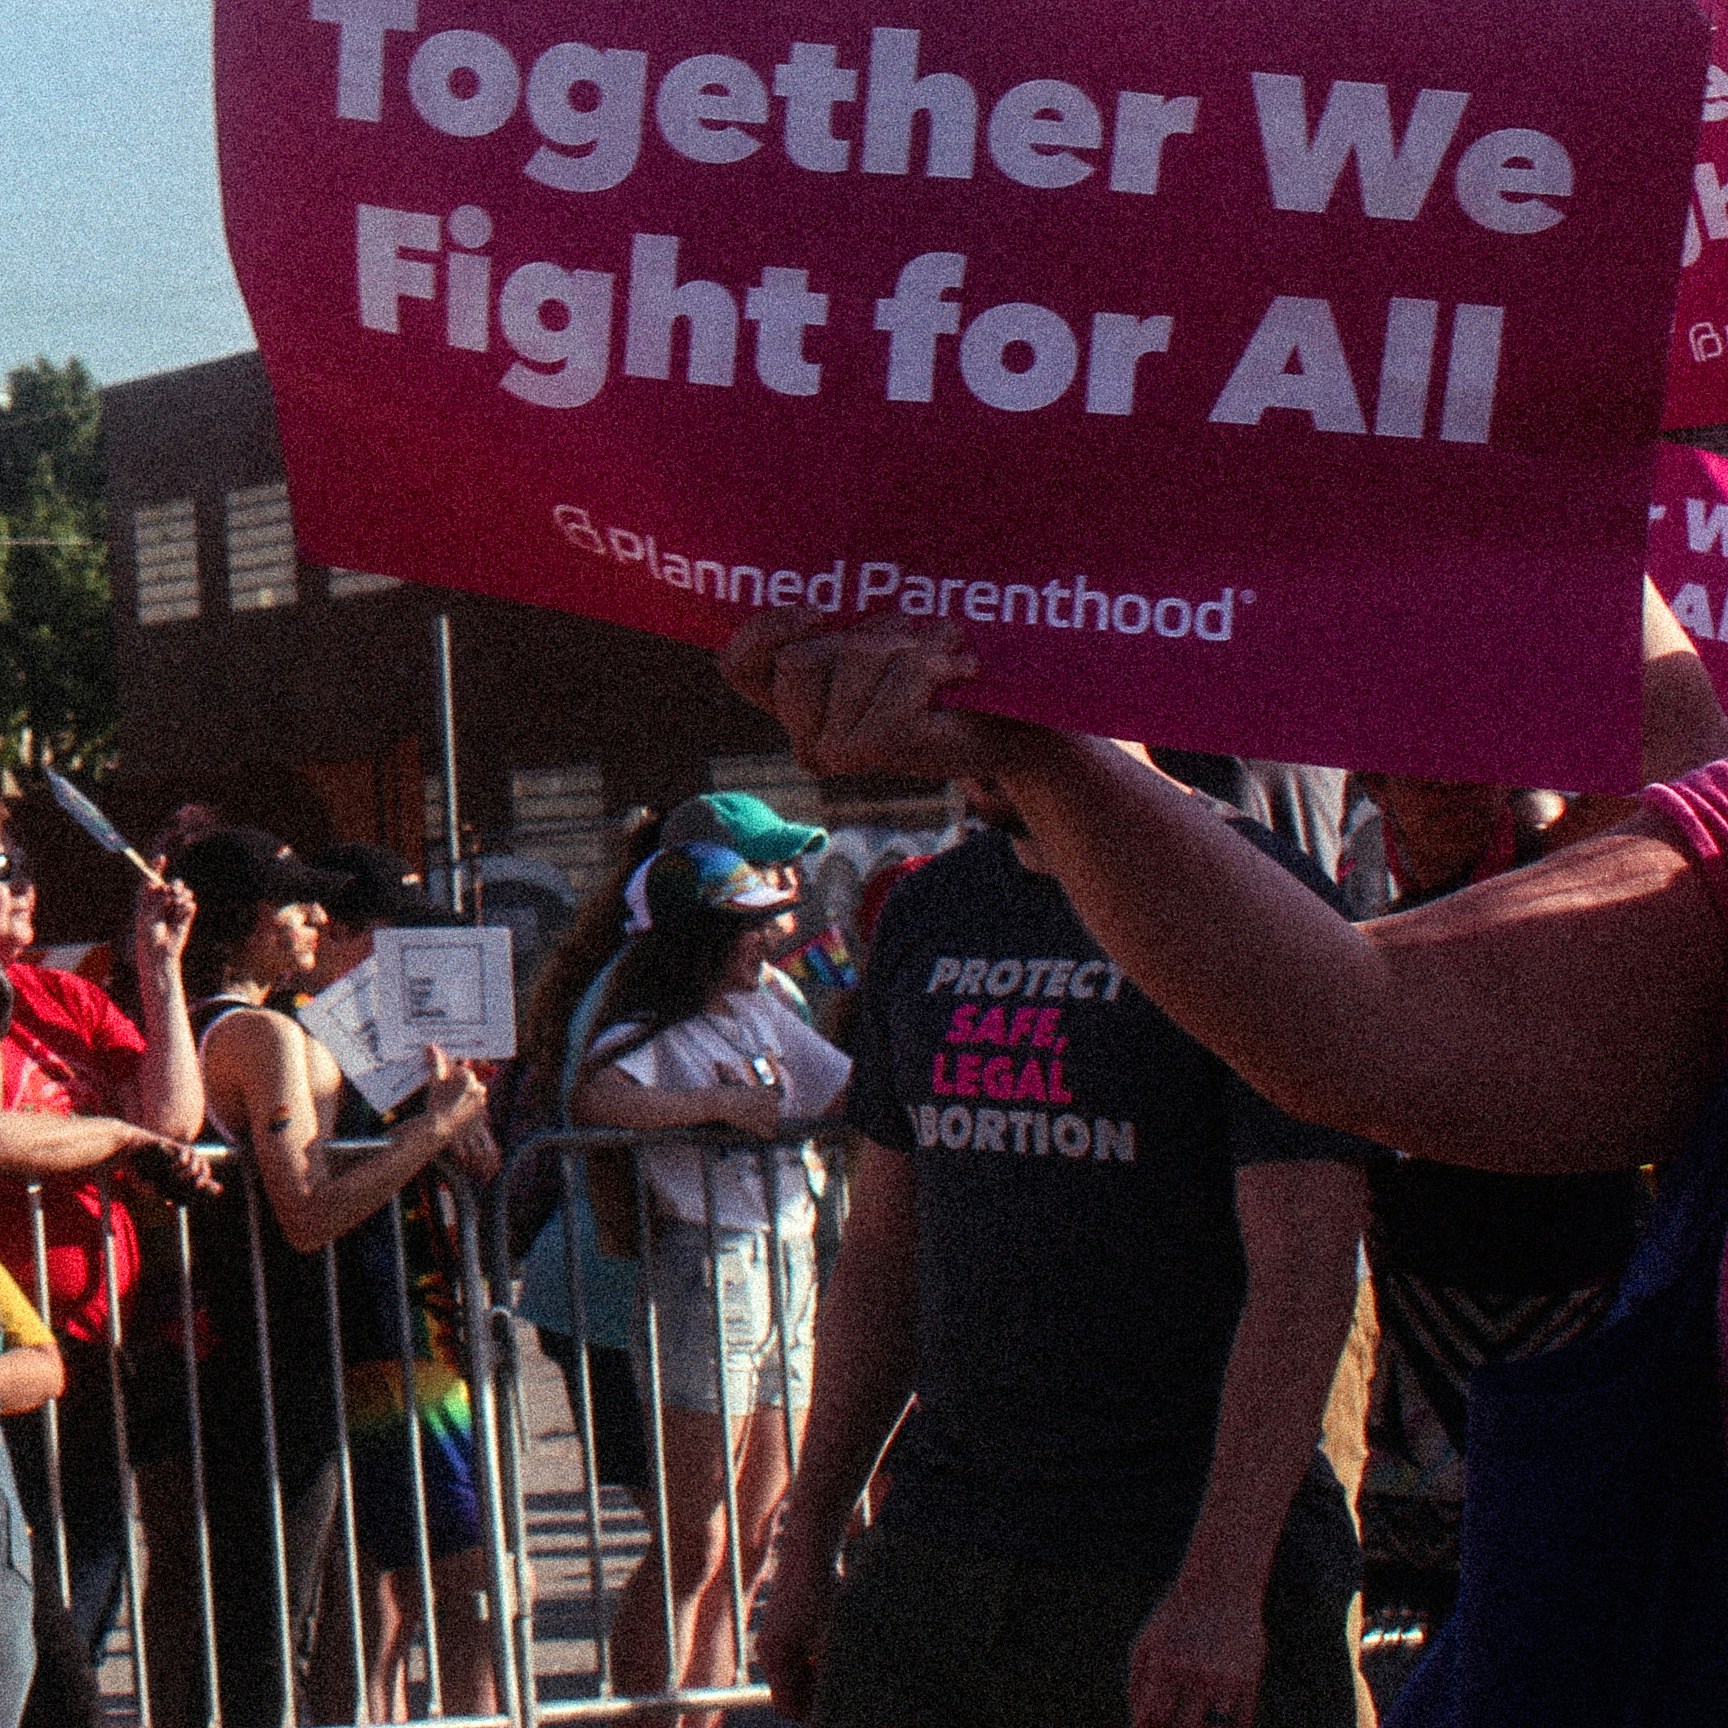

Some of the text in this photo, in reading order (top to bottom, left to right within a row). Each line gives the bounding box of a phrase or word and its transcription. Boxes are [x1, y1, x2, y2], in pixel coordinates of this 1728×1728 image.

[1249, 72, 1576, 235] We
[354, 202, 1507, 446] Fight for All
[606, 525, 846, 614] Planned
[924, 955, 1126, 1003] PROTECT
[944, 1003, 1071, 1056] SAFE,
[930, 1051, 1074, 1105] LEGAL
